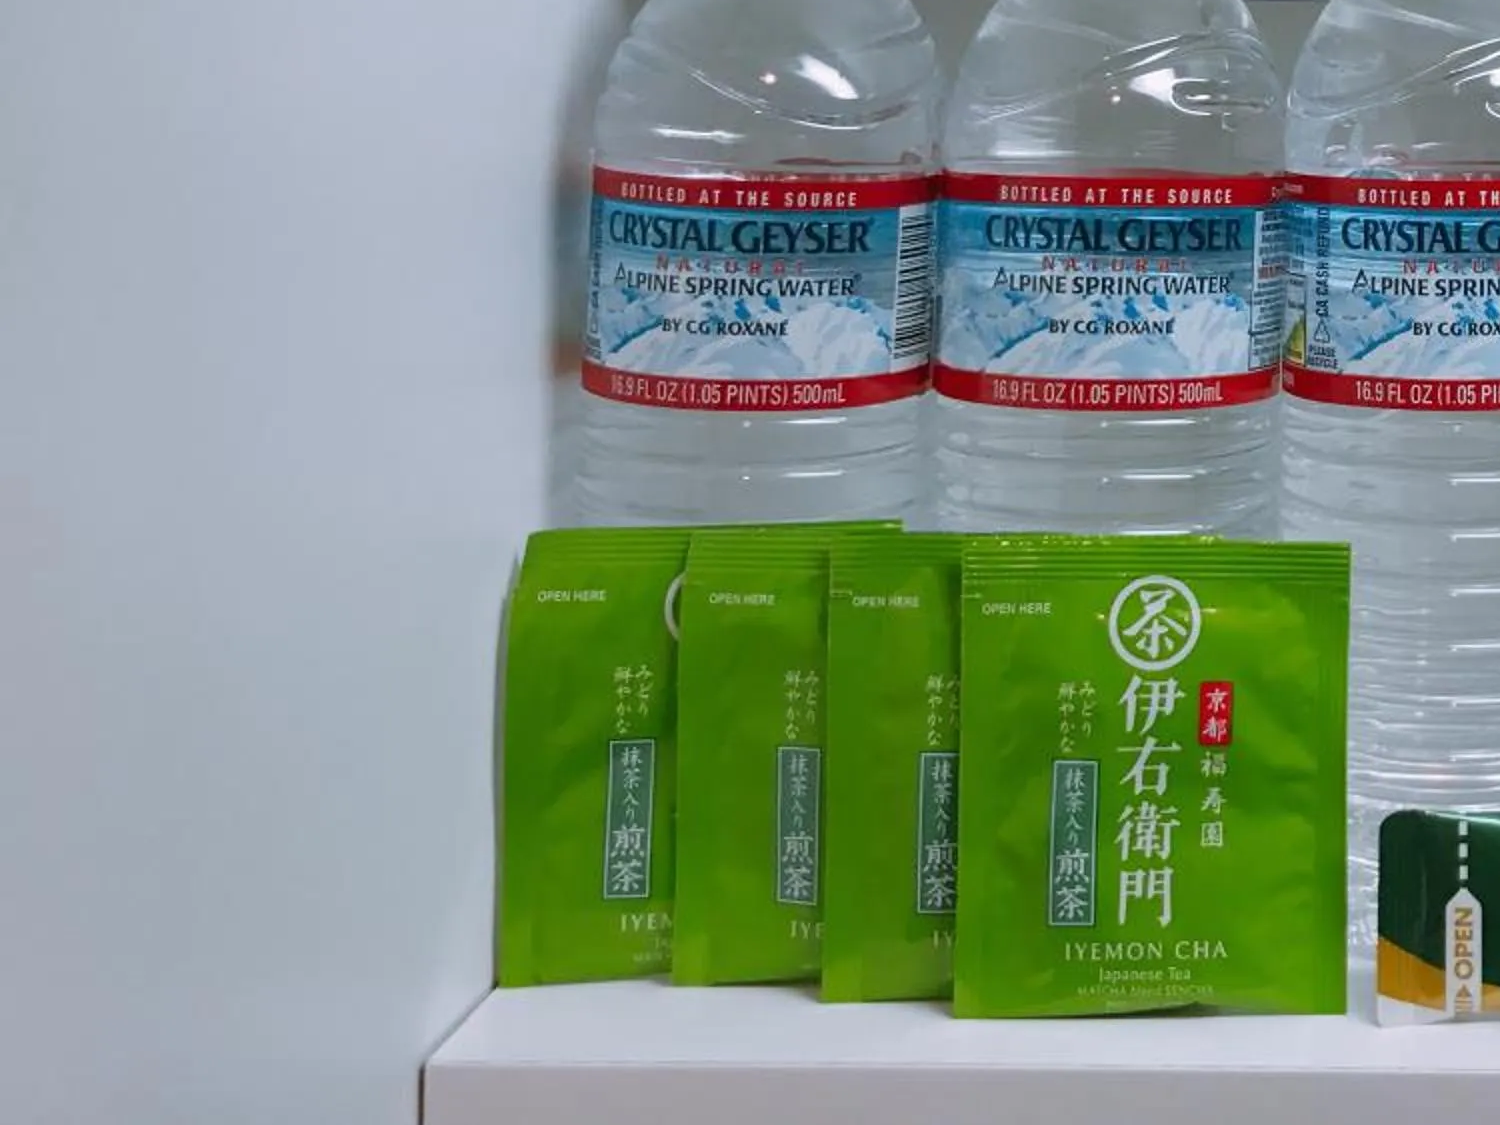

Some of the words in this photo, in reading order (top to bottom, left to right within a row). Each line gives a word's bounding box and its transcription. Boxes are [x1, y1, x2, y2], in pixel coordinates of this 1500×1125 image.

[621, 183, 686, 204] BOTTLED
[699, 190, 721, 204] AT
[736, 191, 769, 206] THE
[784, 191, 857, 207] SOURCE
[1001, 186, 1071, 202] BOTTLED
[1086, 188, 1107, 203] AT
[1122, 188, 1154, 203] THE
[1168, 189, 1233, 204] SOURCE
[1358, 188, 1430, 206] BOTTLED
[1445, 190, 1465, 206] AT
[609, 210, 724, 252] CRYSTAL
[731, 219, 873, 254] GEYSER
[986, 215, 1110, 251] CRYSTAL
[1118, 218, 1241, 251] GEYSER
[1341, 218, 1472, 253] CRYSTAL
[614, 262, 679, 293] ALPINE
[686, 276, 772, 298] SPRING
[778, 276, 855, 297] WATER
[992, 266, 1066, 293] ALPINE
[1072, 276, 1157, 295] SPRING
[1163, 276, 1231, 294] WATER
[1316, 262, 1329, 297] CASH
[1351, 268, 1429, 296] ALPINE
[662, 319, 680, 333] BY
[687, 321, 711, 335] CG
[1049, 321, 1067, 333] BY
[1074, 321, 1099, 334] CG
[1412, 322, 1432, 336] BY
[1438, 322, 1463, 336] CG
[611, 379, 634, 395] 16.9
[637, 380, 652, 400] FL
[656, 381, 678, 401] OZ
[682, 383, 719, 405] (1.05
[727, 383, 787, 406] PINTS)
[793, 384, 846, 404] 500mL
[992, 379, 1017, 399] 16.9
[1022, 382, 1042, 400] FL
[1043, 383, 1066, 403] OZ
[1071, 383, 1110, 404] (1.05
[1115, 382, 1175, 404] PINTS)
[1179, 381, 1223, 402] 500mL
[1355, 379, 1383, 401] 16.9
[1388, 382, 1406, 403] FL
[1411, 384, 1432, 404] OZ
[1437, 383, 1476, 405] (1.05
[537, 590, 570, 602] OPEN
[573, 590, 606, 602] HERE
[709, 593, 740, 605] OPEN
[743, 594, 775, 606] HERE
[852, 595, 885, 607] OPEN
[887, 596, 920, 608] HERE
[982, 603, 1016, 615] OPEN
[1019, 602, 1051, 614] HERE
[1079, 681, 1096, 738] みどり
[1202, 688, 1229, 742] 京都
[1114, 675, 1187, 927] 伊右衛門
[1200, 752, 1227, 847] 福寿園
[1065, 941, 1163, 961] IYEMON
[1175, 940, 1228, 959] CHA
[1454, 907, 1475, 981] OPEN
[1099, 967, 1163, 983] Japanese
[1168, 966, 1191, 981] Tea
